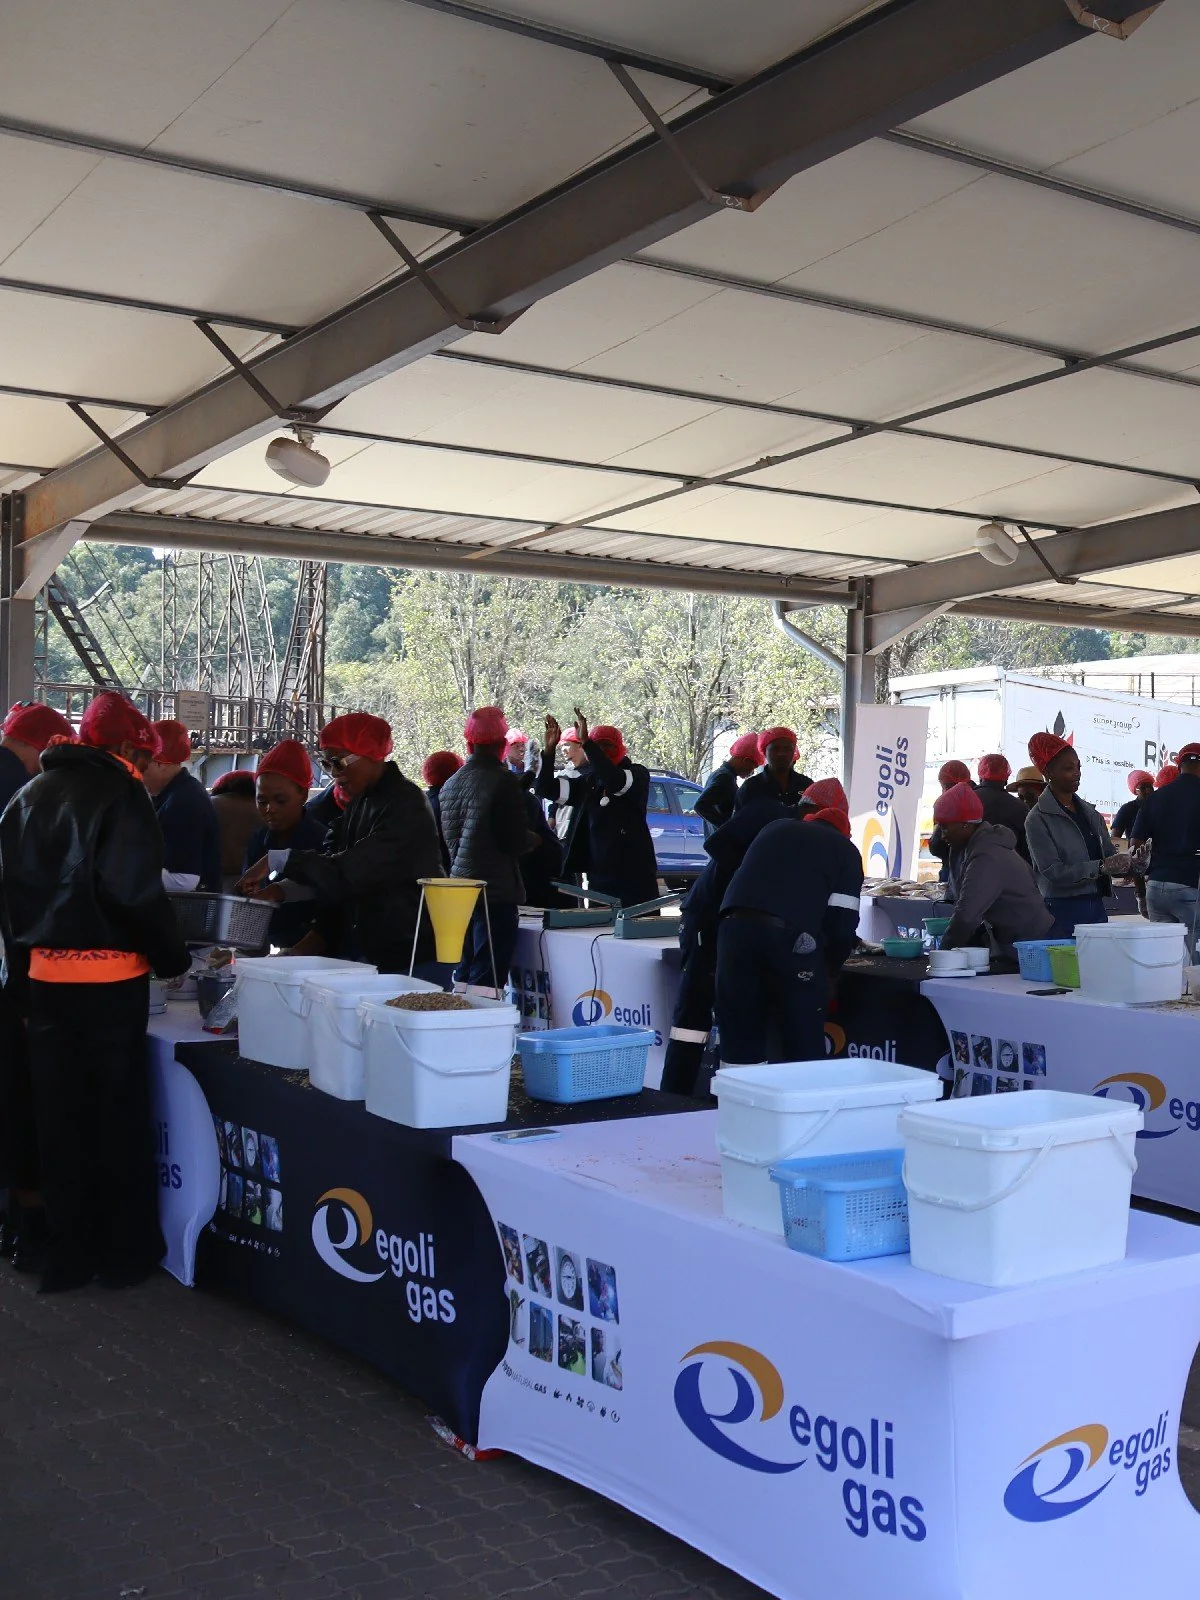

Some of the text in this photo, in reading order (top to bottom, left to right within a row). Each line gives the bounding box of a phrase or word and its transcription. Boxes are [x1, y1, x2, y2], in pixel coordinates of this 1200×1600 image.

[875, 744, 894, 816] egoli
[893, 736, 909, 787] gas
[614, 1003, 651, 1027] egoli
[161, 1162, 183, 1190] as
[375, 1228, 435, 1279] egoli
[406, 1280, 456, 1324] gas
[789, 1404, 894, 1479] egoli
[1108, 1409, 1169, 1470] egoli
[1134, 1446, 1171, 1497] gas
[842, 1478, 927, 1543] gas
